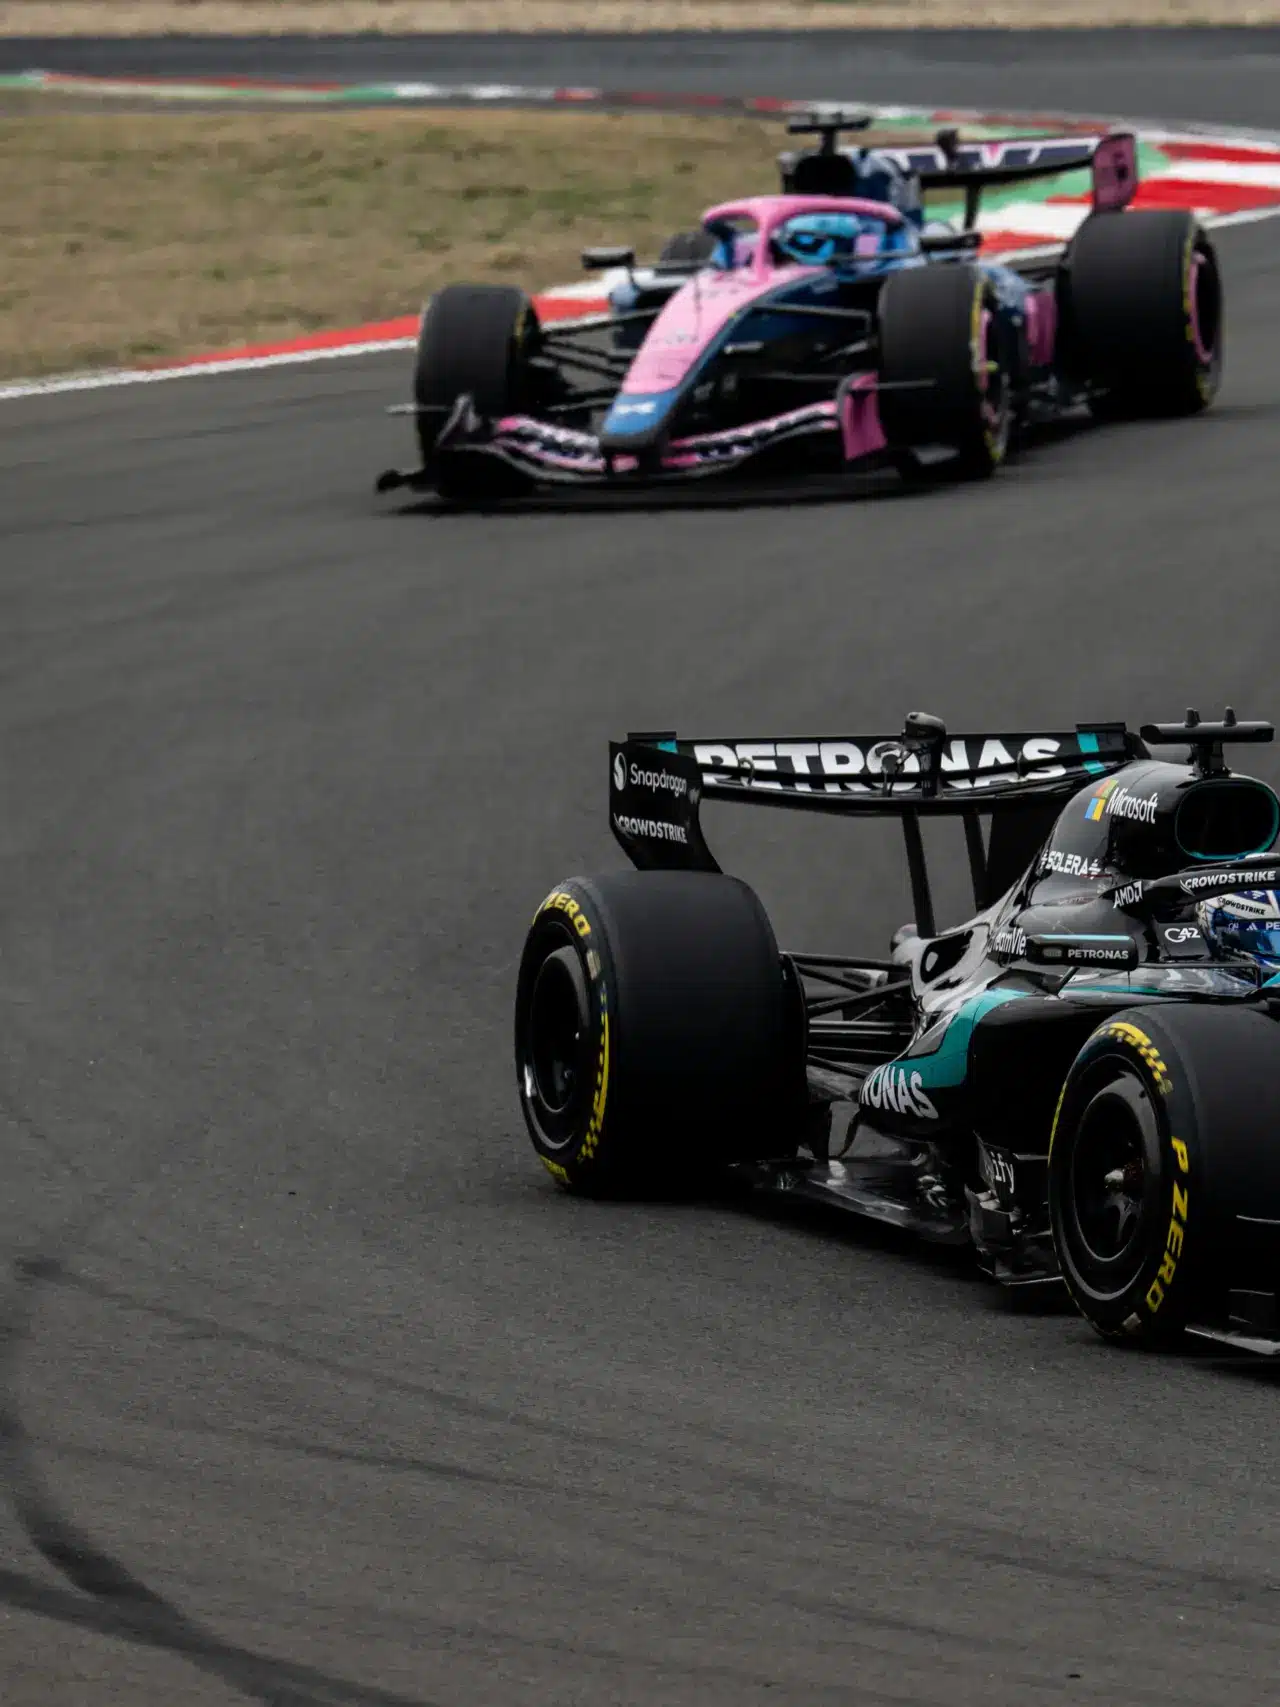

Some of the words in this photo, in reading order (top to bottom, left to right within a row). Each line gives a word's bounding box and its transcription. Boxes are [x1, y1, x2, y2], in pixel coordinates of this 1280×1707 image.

[630, 762, 687, 798] Snapdragon
[694, 738, 1067, 793] PETRONAS
[1106, 787, 1158, 824] Microsoft
[618, 815, 688, 844] CROWDSTRIKE
[1045, 850, 1089, 876] SOLERA
[1186, 870, 1277, 889] CROWDSTRIKE
[1113, 884, 1135, 909] AMD
[995, 927, 1027, 956] eamVie
[1067, 949, 1129, 959] PETRONAS
[1171, 1136, 1189, 1173] P
[1146, 1180, 1188, 1313] ZERO
